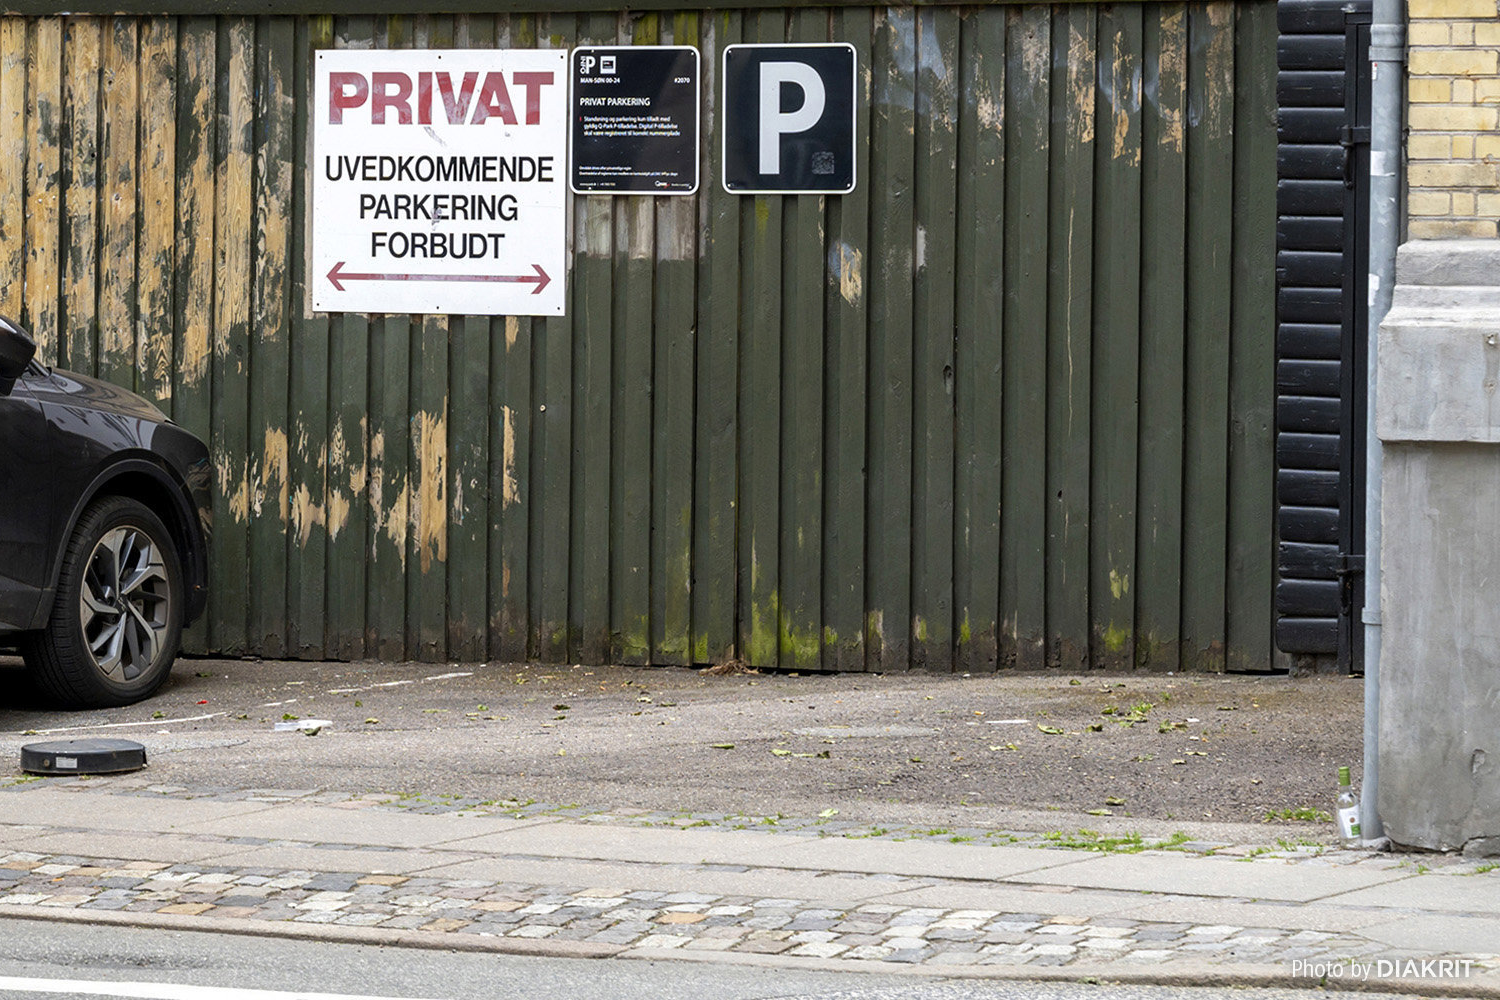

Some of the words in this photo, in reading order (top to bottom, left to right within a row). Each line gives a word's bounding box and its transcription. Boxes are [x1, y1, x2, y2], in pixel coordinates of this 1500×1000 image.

[329, 70, 554, 126] PRIVAT
[579, 97, 606, 106] PRIVAT
[607, 97, 651, 106] PARKERING
[759, 61, 826, 175] P
[325, 154, 554, 184] UVEDKOMMENDE
[359, 193, 520, 223] PARKERING
[371, 231, 505, 260] FORBUDT
